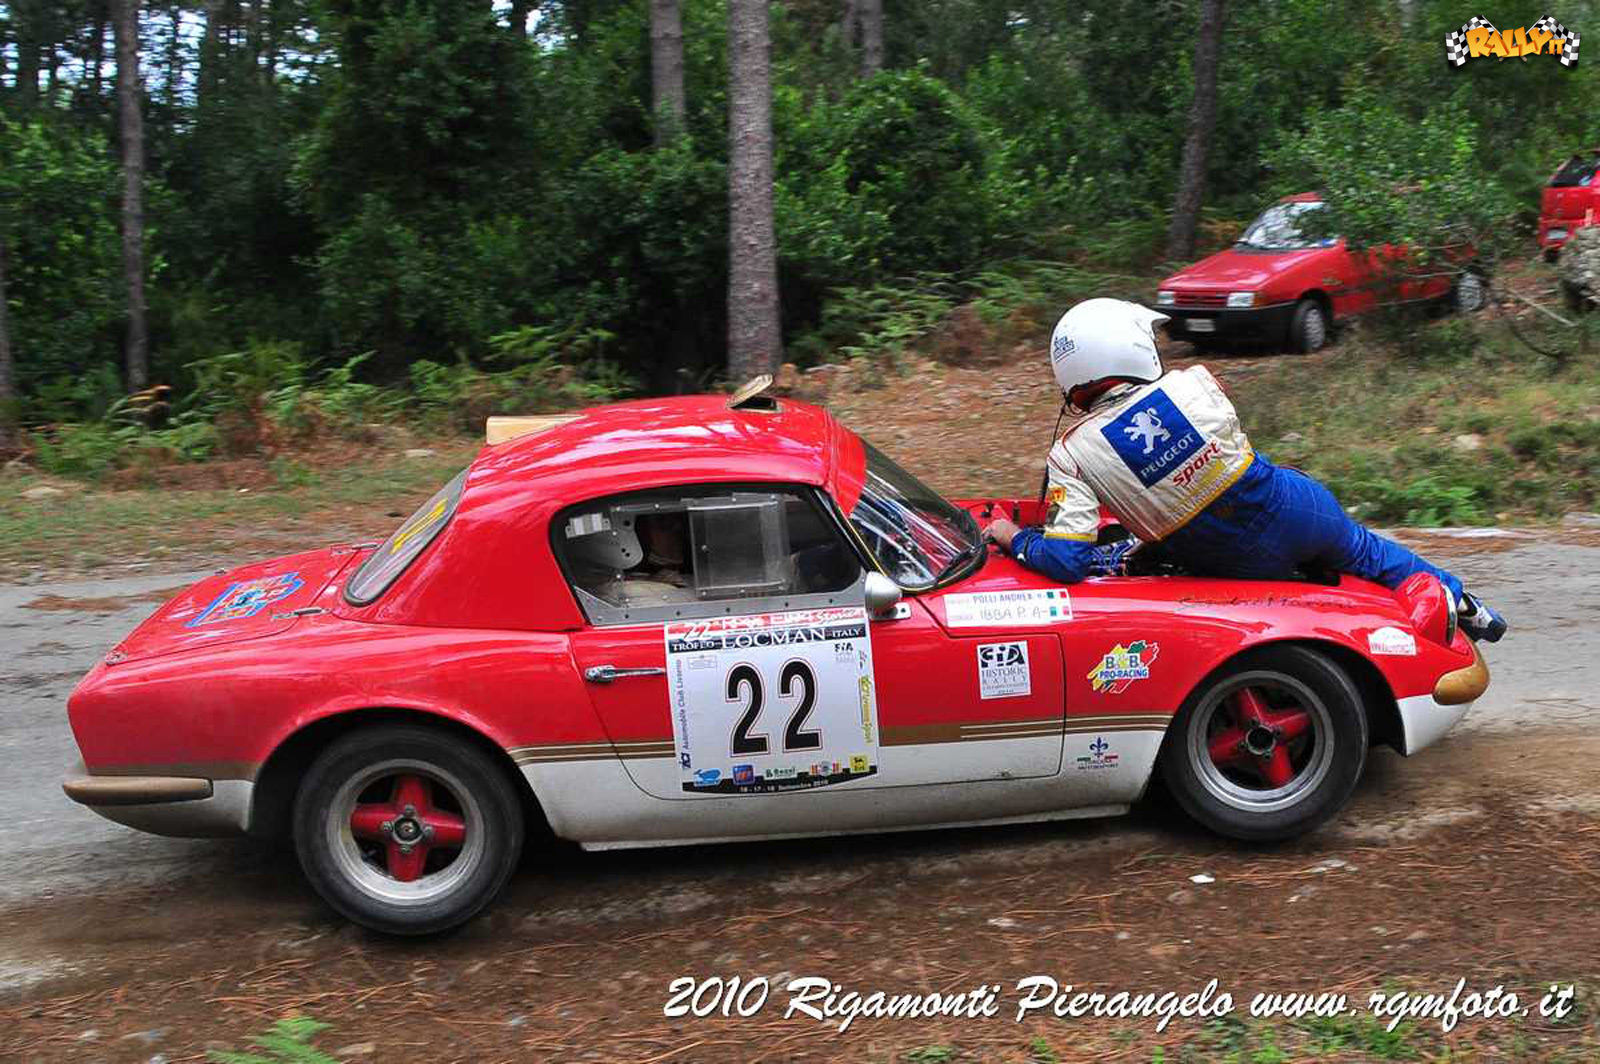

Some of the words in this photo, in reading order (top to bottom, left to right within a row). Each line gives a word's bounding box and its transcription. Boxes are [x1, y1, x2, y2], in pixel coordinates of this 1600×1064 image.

[1141, 432, 1196, 478] PEUGEOT
[1173, 440, 1221, 486] sport
[671, 640, 715, 651] TROFEO
[722, 627, 826, 649] LOCMAN
[832, 628, 860, 638] ITALY
[834, 642, 854, 652] FIA
[980, 644, 1025, 668] FIA
[981, 667, 1025, 678] HISTORIC
[1099, 668, 1148, 678] PRO-RACING
[726, 658, 821, 756] 22
